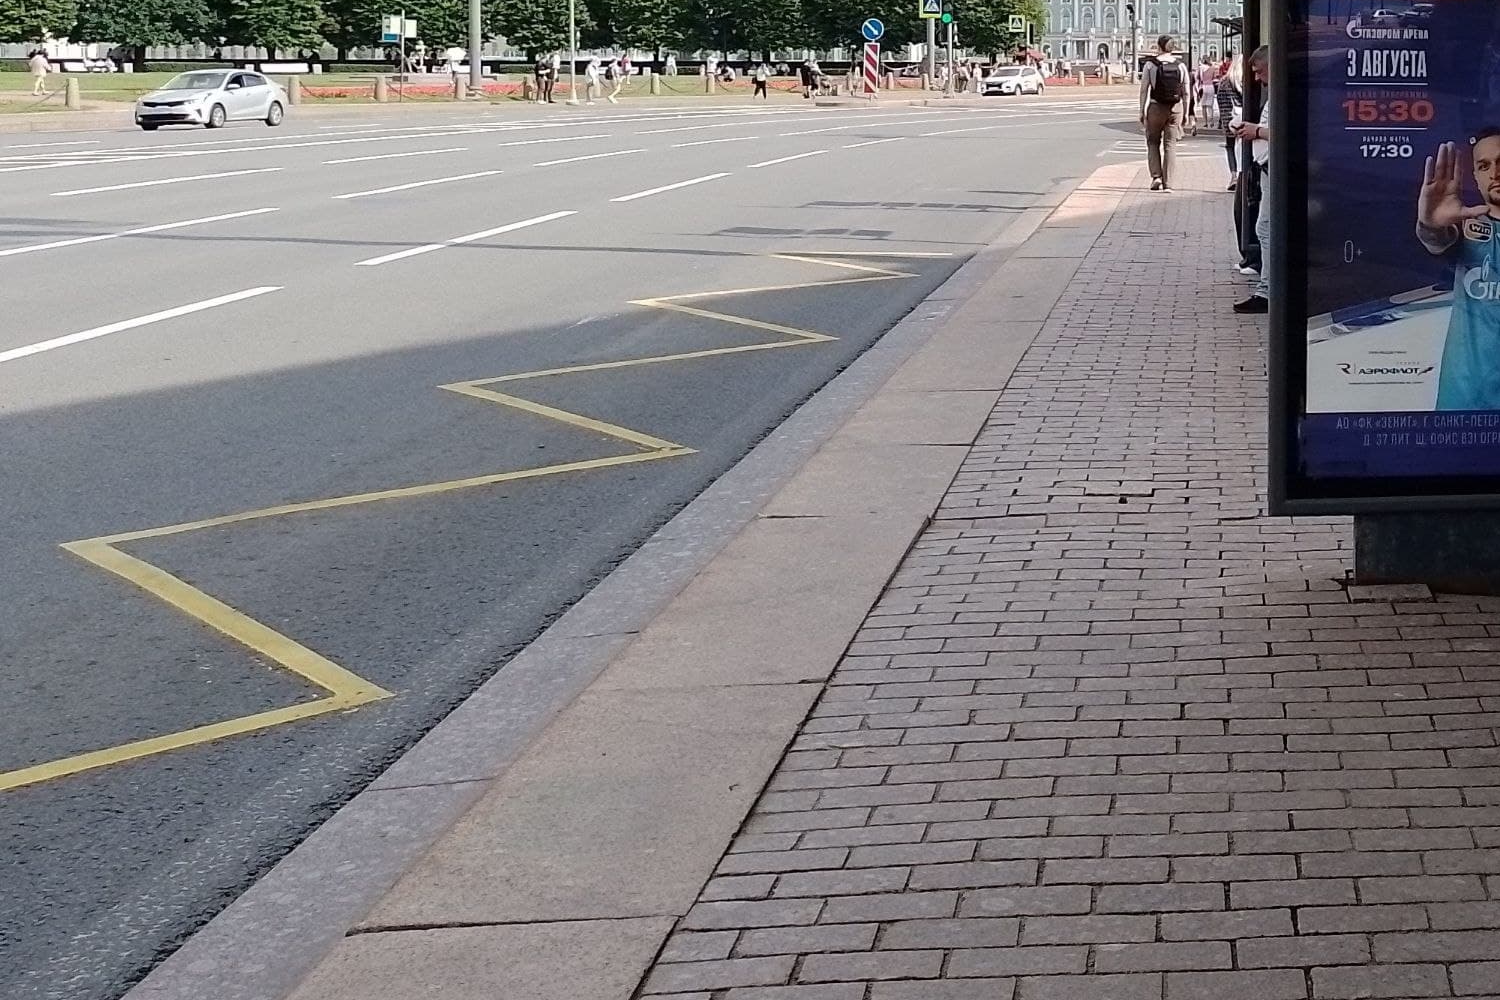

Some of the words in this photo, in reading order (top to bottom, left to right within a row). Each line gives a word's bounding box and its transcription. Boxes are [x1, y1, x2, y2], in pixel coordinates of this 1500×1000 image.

[1346, 48, 1357, 77] 3
[1361, 49, 1428, 78] АВГУСТА
[1342, 100, 1435, 121] 15:30
[1359, 144, 1413, 158] 17:30
[1358, 367, 1420, 375] АЭРОФЛОТ
